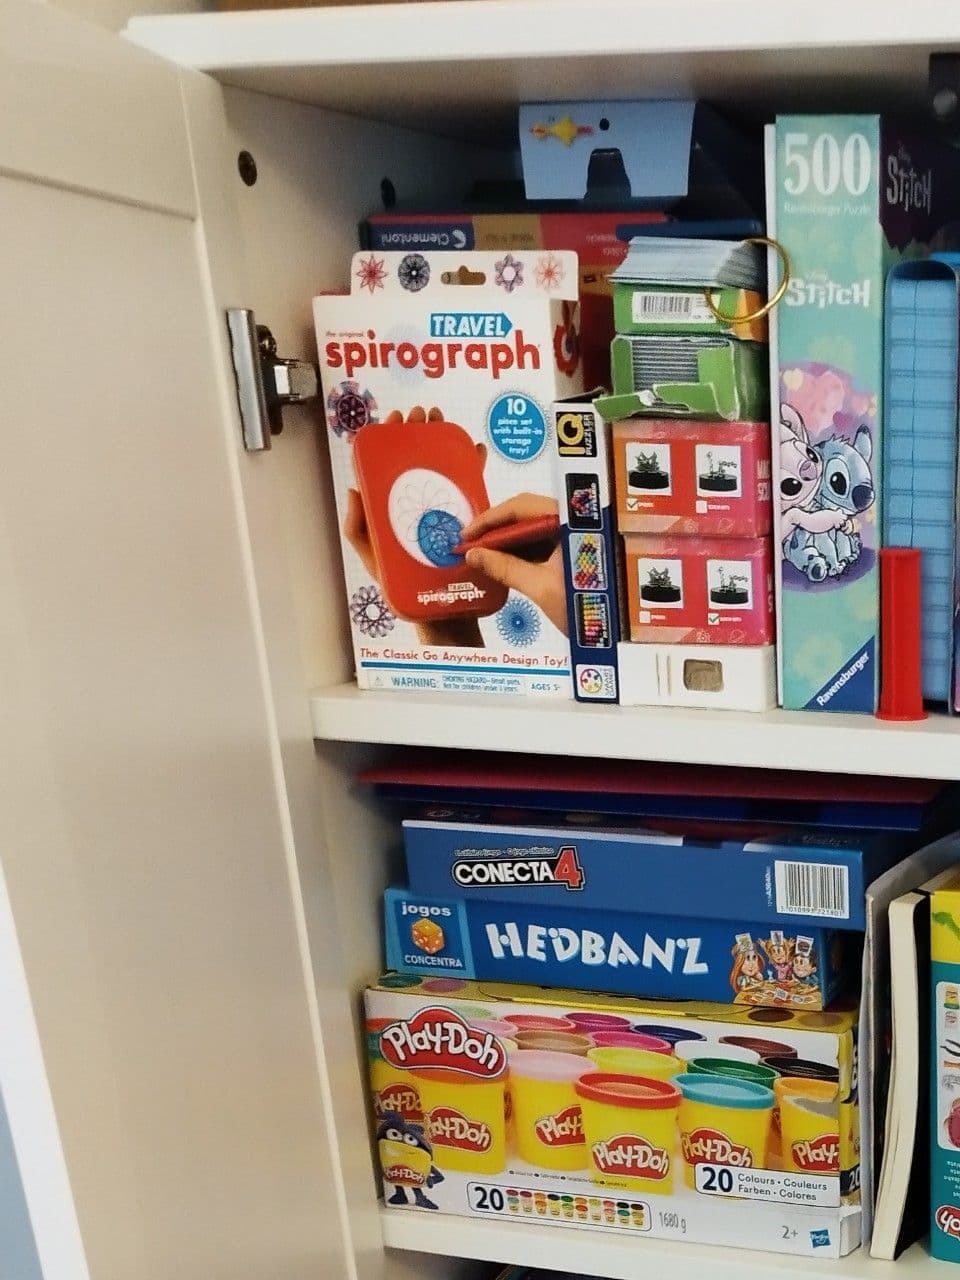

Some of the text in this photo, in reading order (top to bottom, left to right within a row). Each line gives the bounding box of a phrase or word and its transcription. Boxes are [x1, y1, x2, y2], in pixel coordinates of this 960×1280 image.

[784, 132, 871, 195] 500
[381, 232, 449, 247] Clementoni
[433, 315, 505, 336] TRAVEL
[326, 329, 540, 379] spirograph
[507, 398, 526, 415] 10
[557, 413, 585, 455] IQ
[417, 589, 486, 605] spirograph
[360, 649, 568, 668] The Classic Go Anywhere Design Toy!
[816, 650, 870, 707] Ravensburger
[455, 849, 582, 888] CONECTA 4
[402, 901, 452, 917] jogos
[485, 921, 710, 976] HEDBANZ
[404, 954, 463, 968] CONCENTRA
[382, 1022, 500, 1070] Play-Doh
[537, 1116, 584, 1143] Play-
[593, 1143, 669, 1173] Play-Doh
[792, 1141, 840, 1166] Play-
[702, 1167, 828, 1193] 20 Colours Couleurs
[474, 1187, 504, 1211] 20
[739, 1184, 816, 1201] Farben Colores
[659, 1212, 680, 1228] 1680
[782, 1225, 798, 1239] 2+
